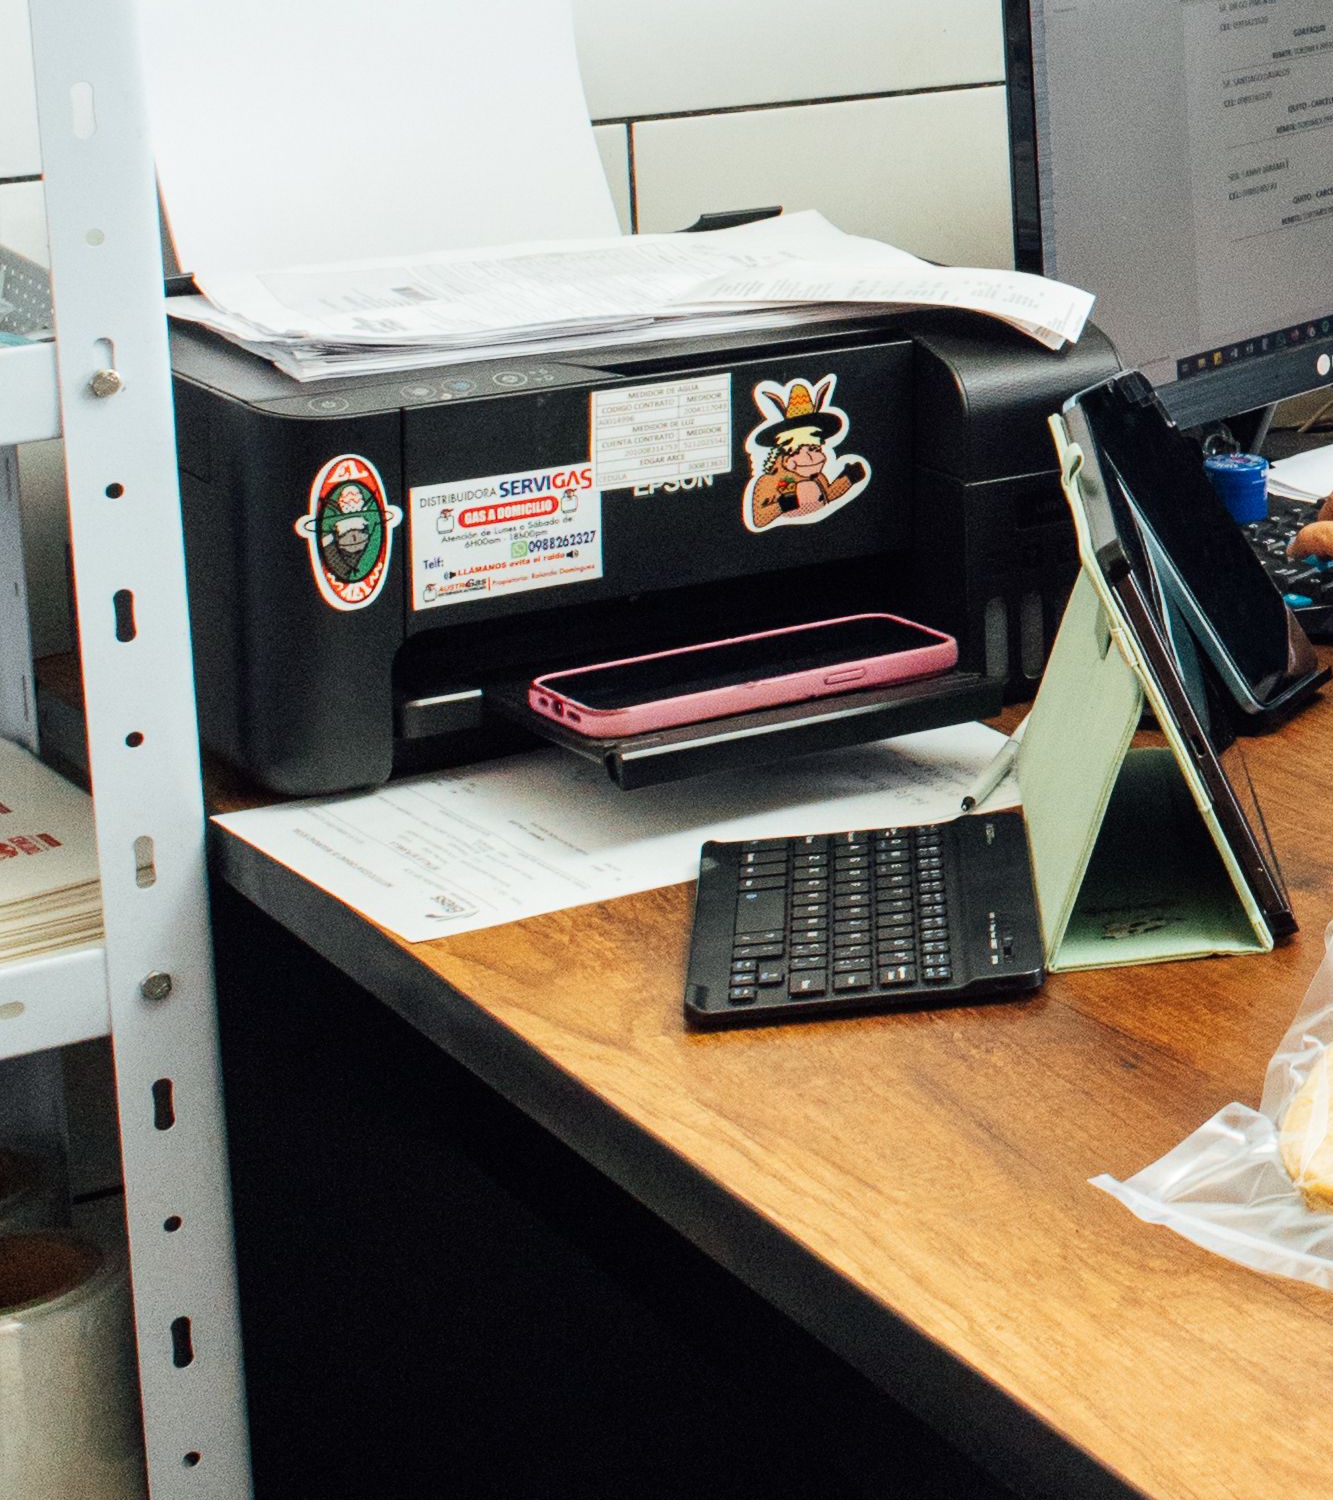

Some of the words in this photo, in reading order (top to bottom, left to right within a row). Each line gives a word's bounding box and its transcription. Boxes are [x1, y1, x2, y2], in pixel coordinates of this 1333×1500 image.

[628, 388, 664, 399] MEDIDOR
[666, 386, 676, 395] DE
[677, 384, 699, 392] AGUA
[687, 392, 722, 402] MEDIDOR
[634, 399, 675, 410] CONTRATO
[632, 422, 668, 433] MEDIDOR
[670, 421, 679, 429] DE
[681, 418, 695, 427] LUZ
[687, 426, 722, 437] MEDIDOR
[602, 438, 632, 449] CUENTA
[634, 433, 674, 445] CONTRATO
[640, 455, 666, 466] EDGAR
[667, 453, 685, 463] ARCE
[420, 488, 496, 508] DISTRIBUIDORA
[499, 469, 592, 497] SERVIGAS
[464, 508, 486, 525] GAS
[488, 506, 496, 521] A
[498, 499, 553, 519] DOMICILIO
[481, 527, 491, 537] de
[494, 524, 517, 536] Lunes
[528, 515, 560, 530] Sábado
[563, 515, 572, 523] de
[528, 530, 597, 553] 0988262327
[423, 557, 444, 570] Telf:
[509, 557, 530, 568] evita
[544, 551, 565, 562] ruido
